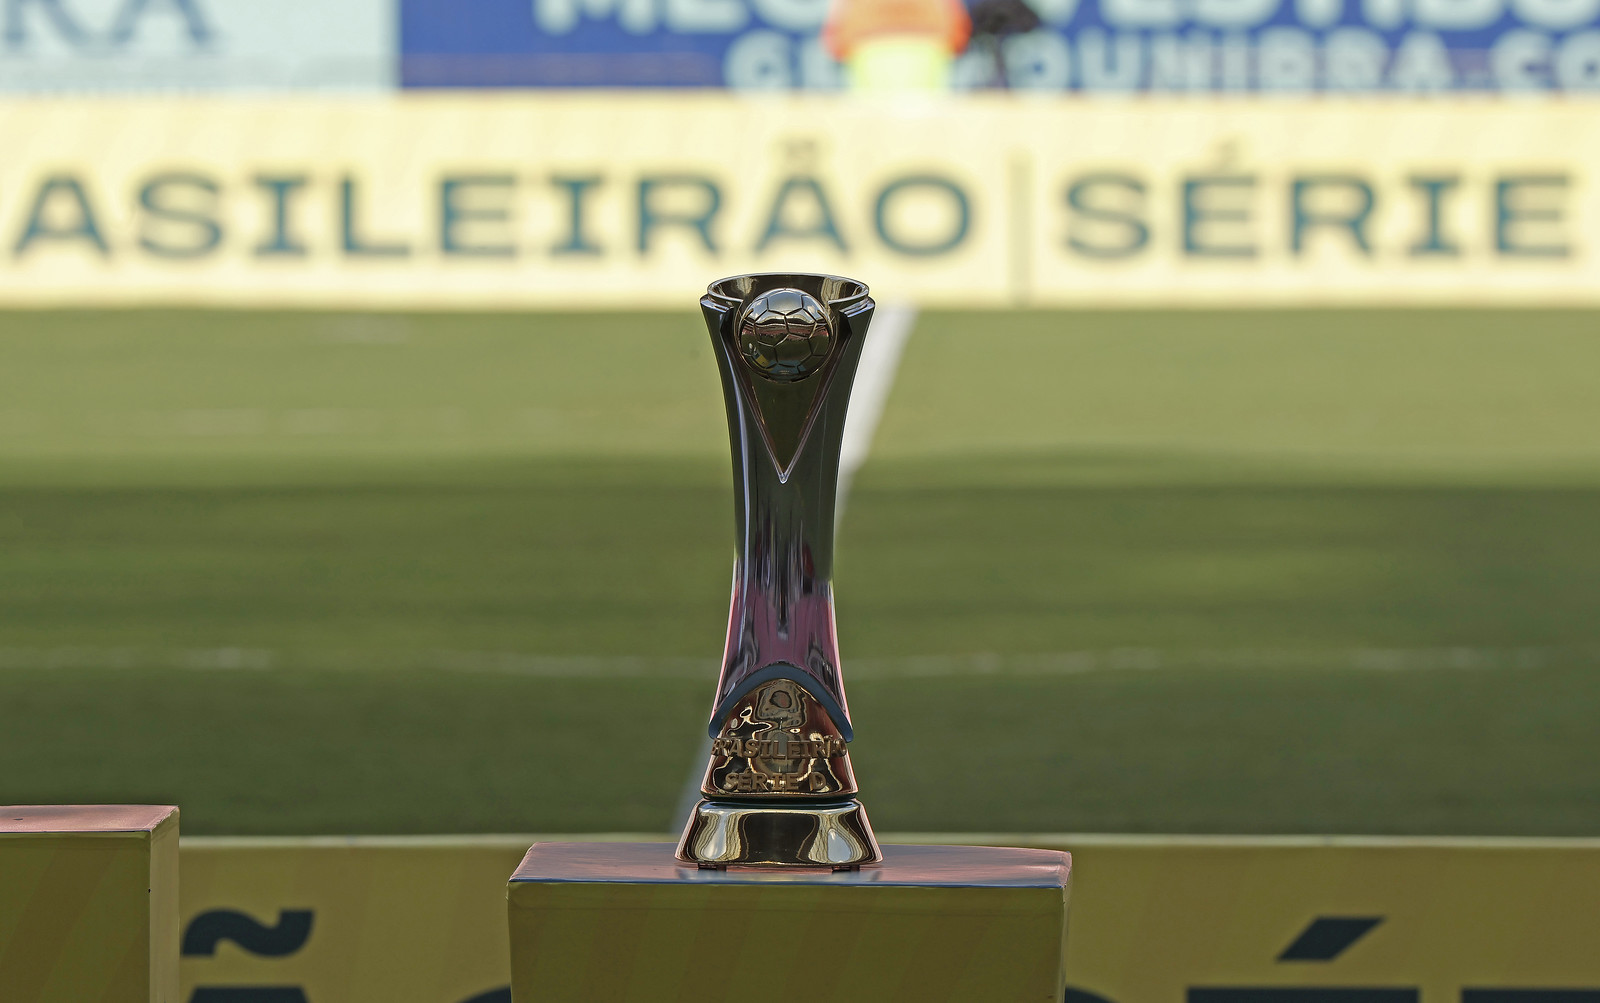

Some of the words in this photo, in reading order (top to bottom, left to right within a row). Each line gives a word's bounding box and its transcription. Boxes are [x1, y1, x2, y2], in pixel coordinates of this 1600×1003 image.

[1063, 139, 1572, 259] SÉRIE
[723, 766, 799, 792] SÉRIE
[809, 771, 827, 791] D
